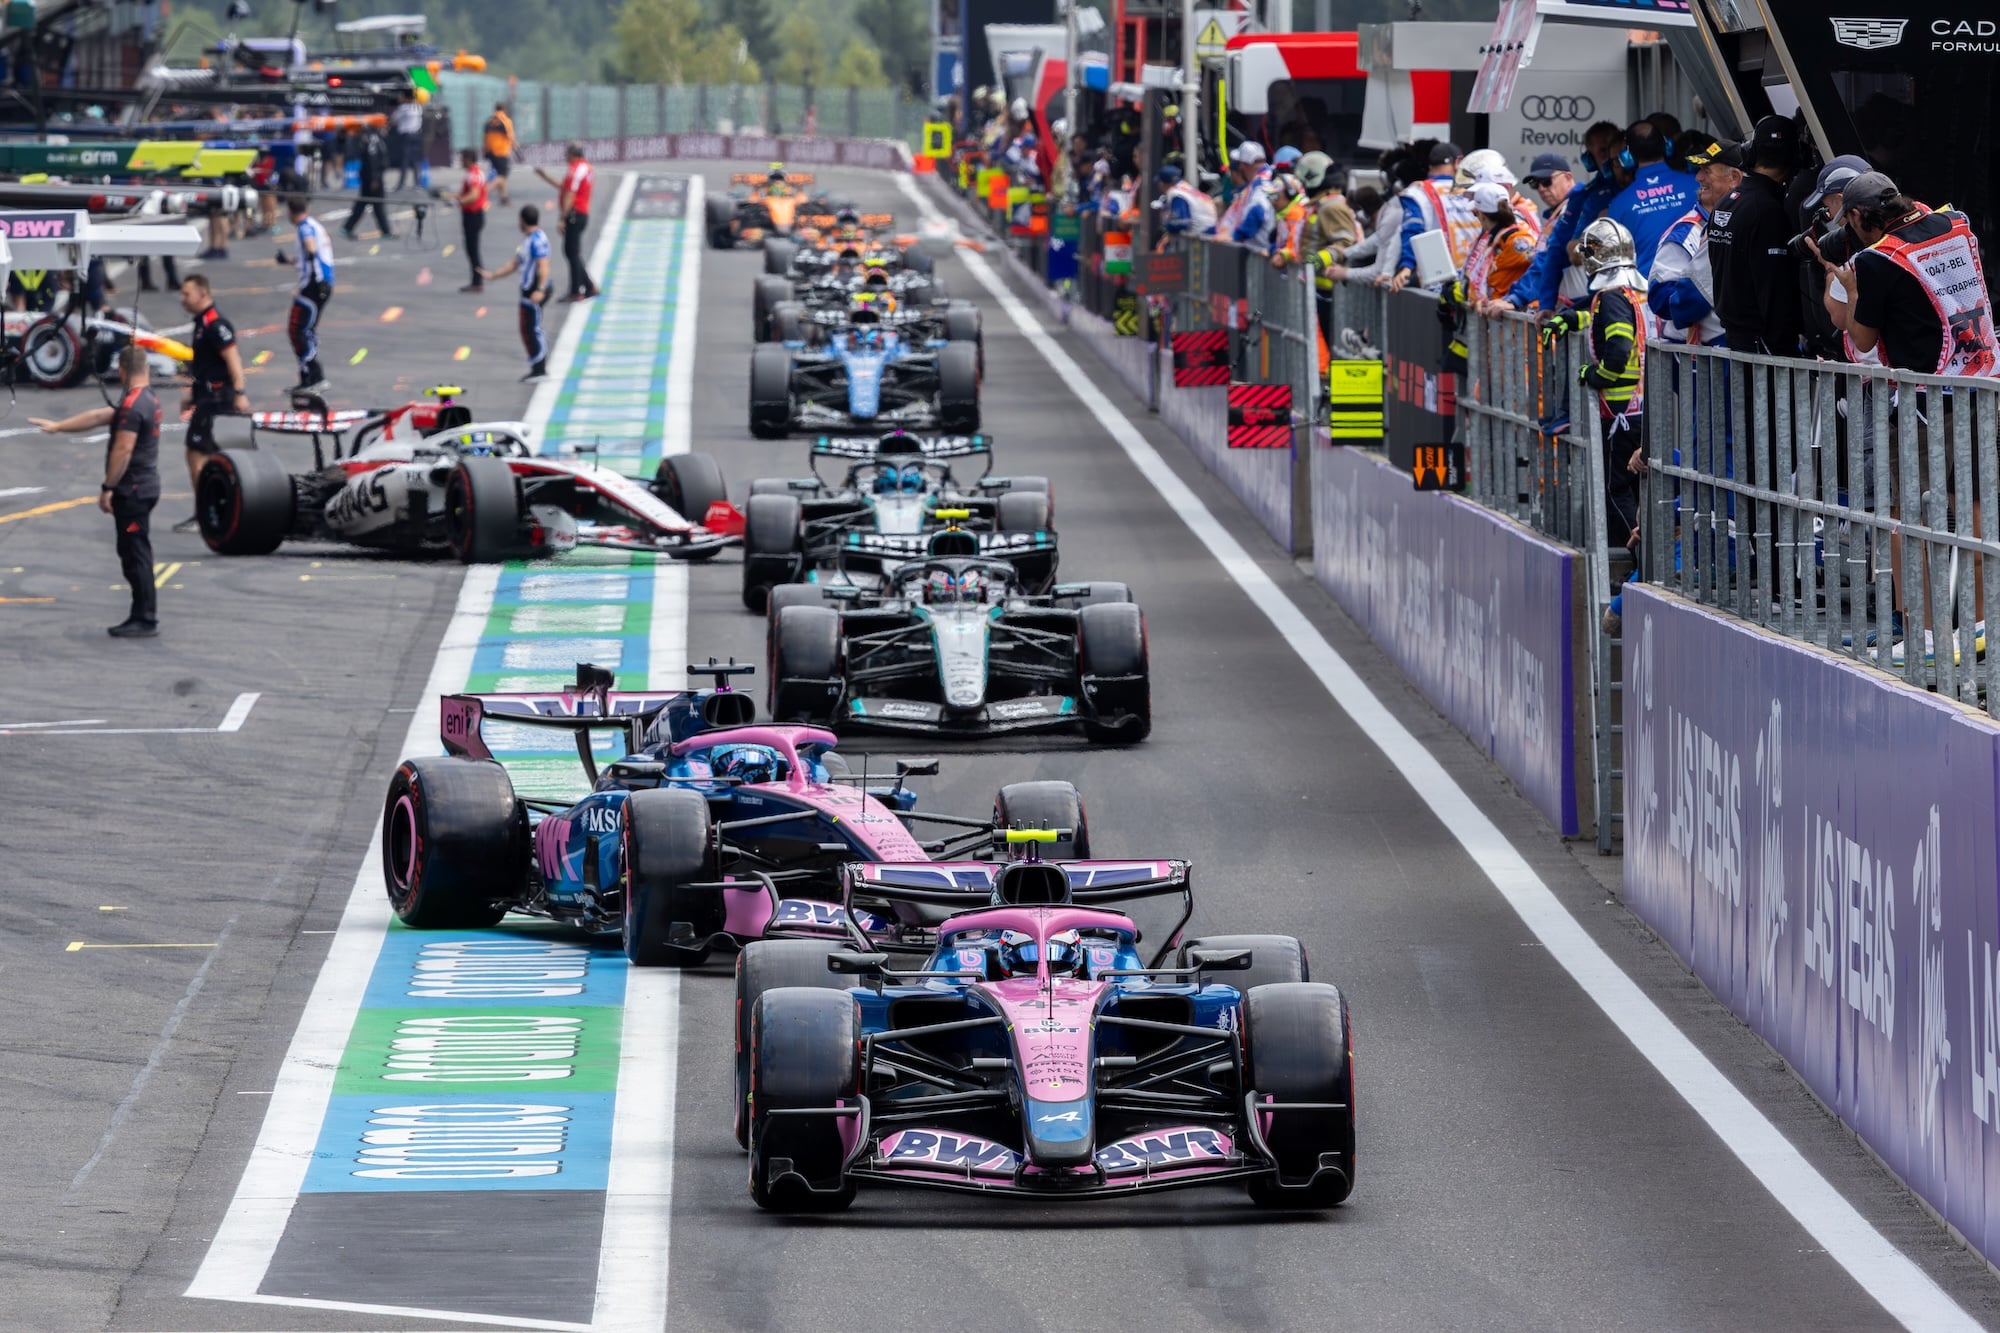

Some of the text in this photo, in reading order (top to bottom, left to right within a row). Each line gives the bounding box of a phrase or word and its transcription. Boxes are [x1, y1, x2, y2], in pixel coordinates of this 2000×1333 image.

[1632, 192, 1686, 211] ALPINE
[1648, 184, 1673, 197] BWT
[12, 219, 65, 238] BWT
[446, 708, 465, 737] eni
[588, 807, 621, 833] MS
[1669, 705, 1741, 908] LAS VEGAS
[1804, 805, 1896, 1042] LAS VEGAS
[403, 940, 594, 999] aramco
[379, 1015, 590, 1082] aramco
[1967, 930, 2000, 1136] LA
[350, 1103, 574, 1179] aramco
[891, 1129, 1025, 1172] BWT
[1094, 1130, 1223, 1170] BWT
